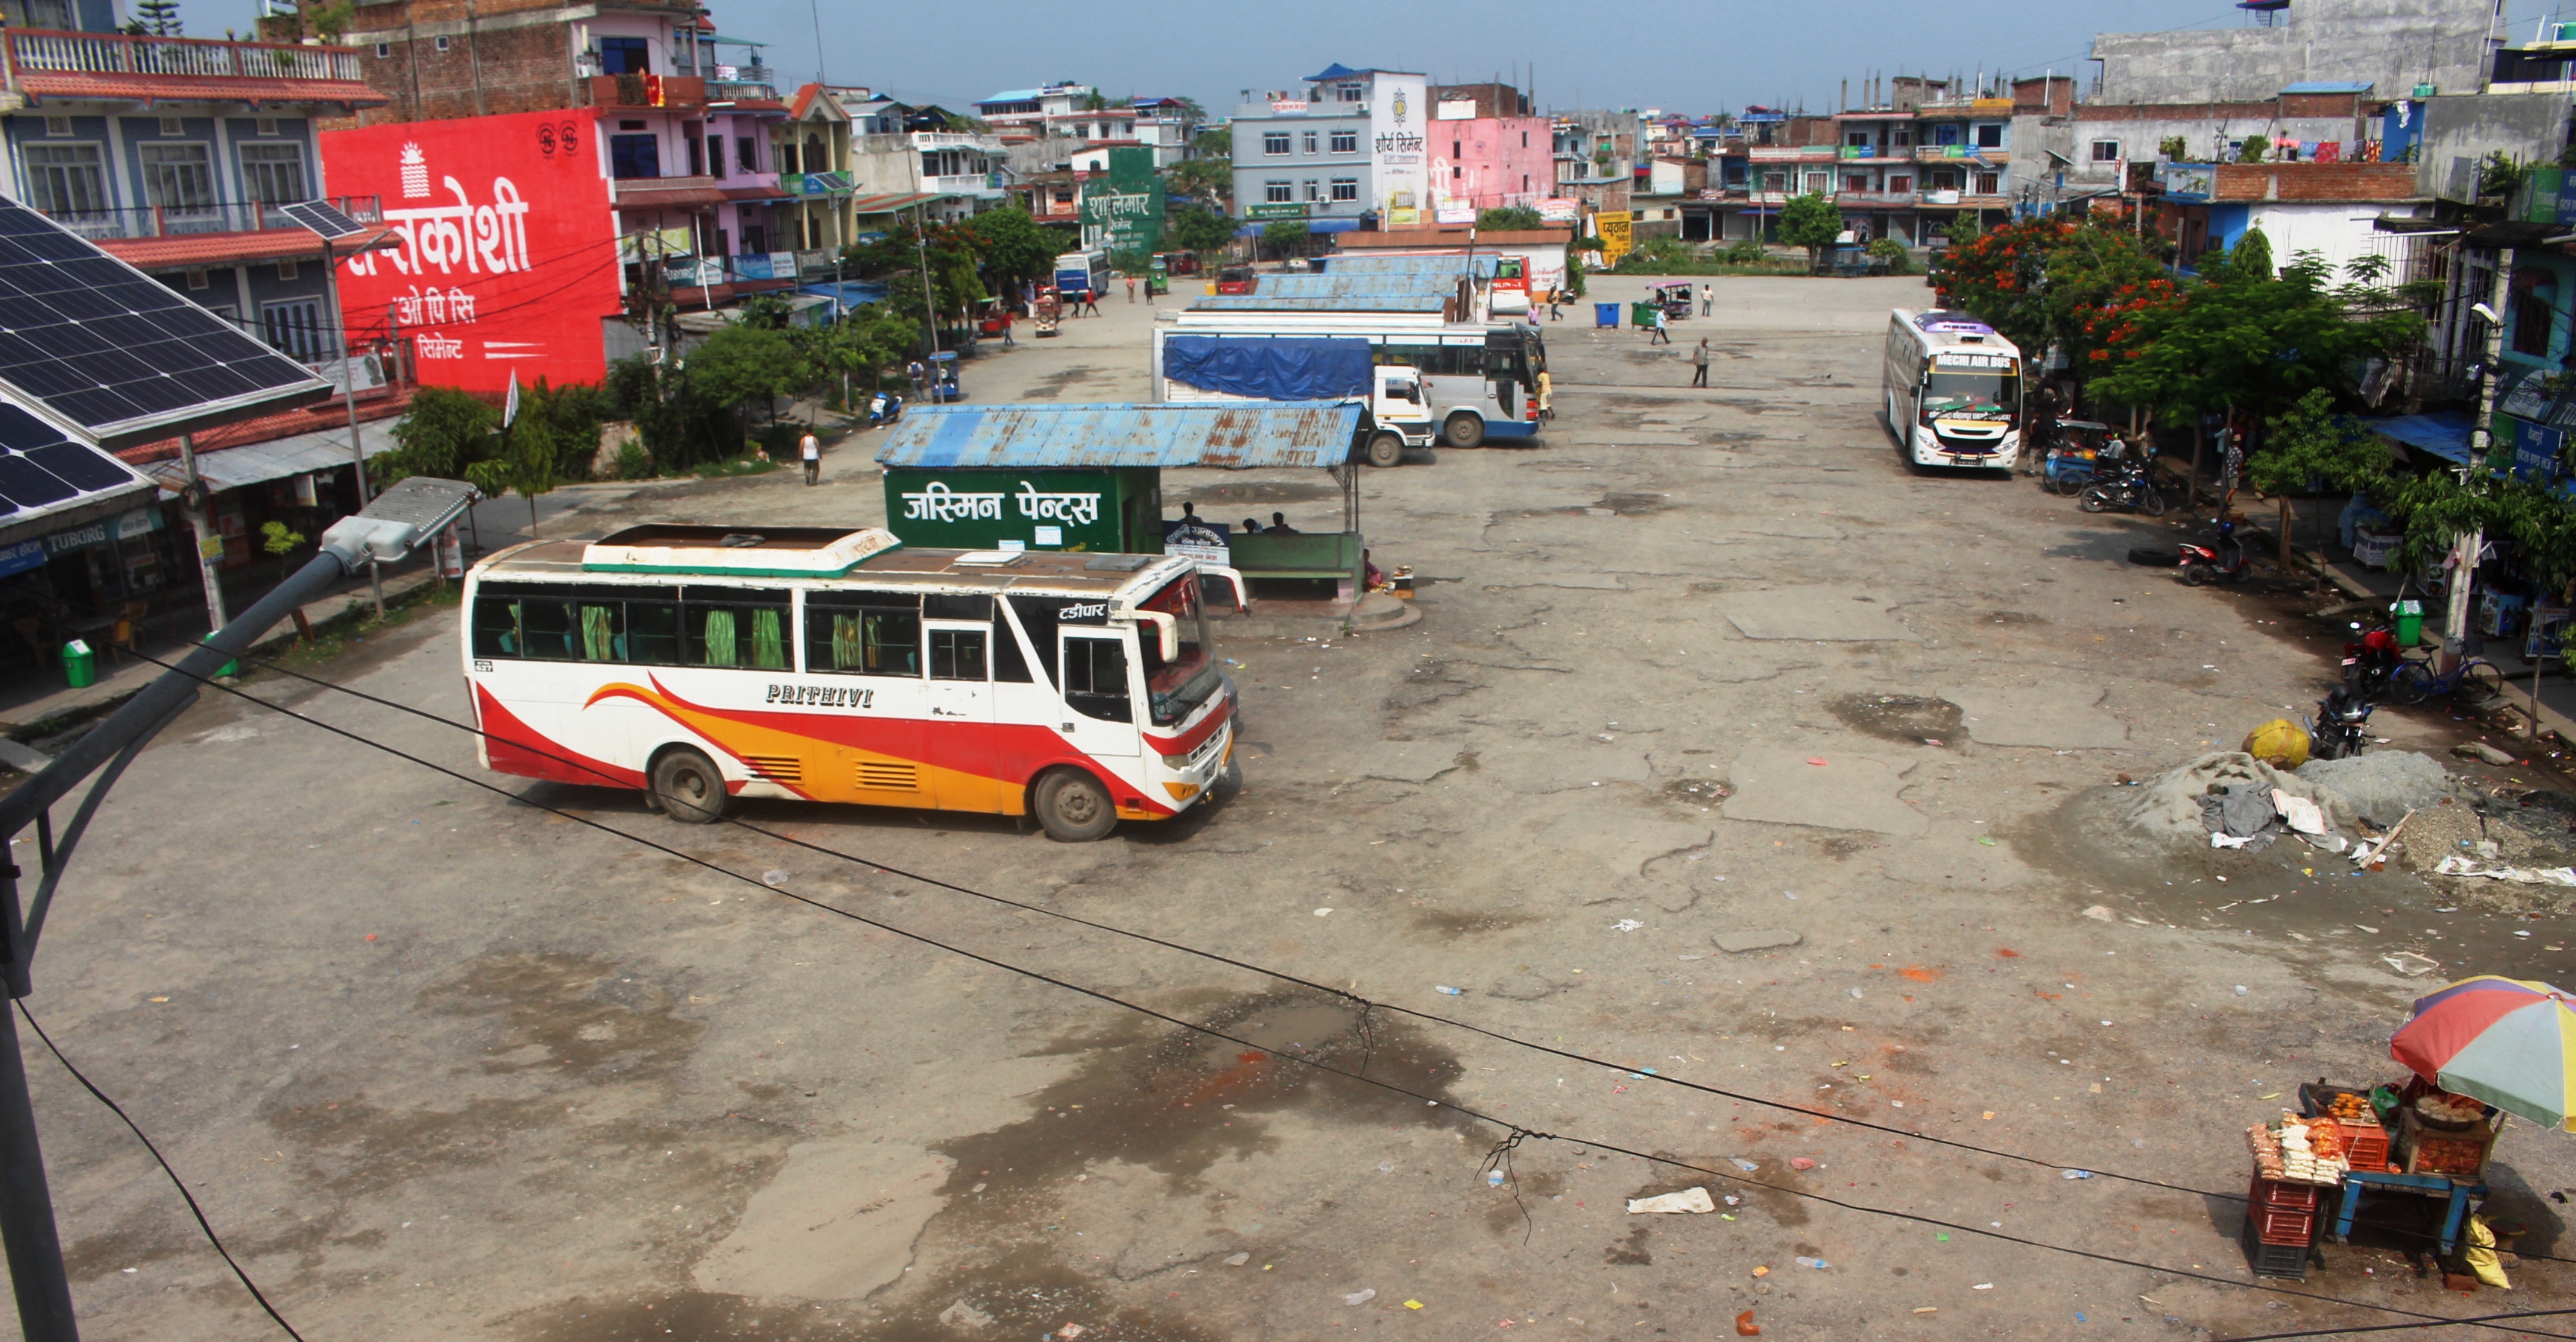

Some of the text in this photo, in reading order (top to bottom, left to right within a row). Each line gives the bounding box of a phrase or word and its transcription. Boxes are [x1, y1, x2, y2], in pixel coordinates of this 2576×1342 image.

[1375, 131, 1423, 153] शौर्य सिमेन्ट
[347, 175, 531, 276] तकोशी
[425, 287, 446, 324] पि
[448, 287, 476, 323] सि
[417, 332, 463, 358] सिमेन्ट
[1937, 354, 2011, 367] MECHI AIR BUS
[902, 481, 1101, 527] जस्मिन पेन्ट्स
[47, 524, 105, 553] TUBORG
[1059, 604, 1106, 619] टडीपार
[766, 684, 874, 708] PRITHIVI
